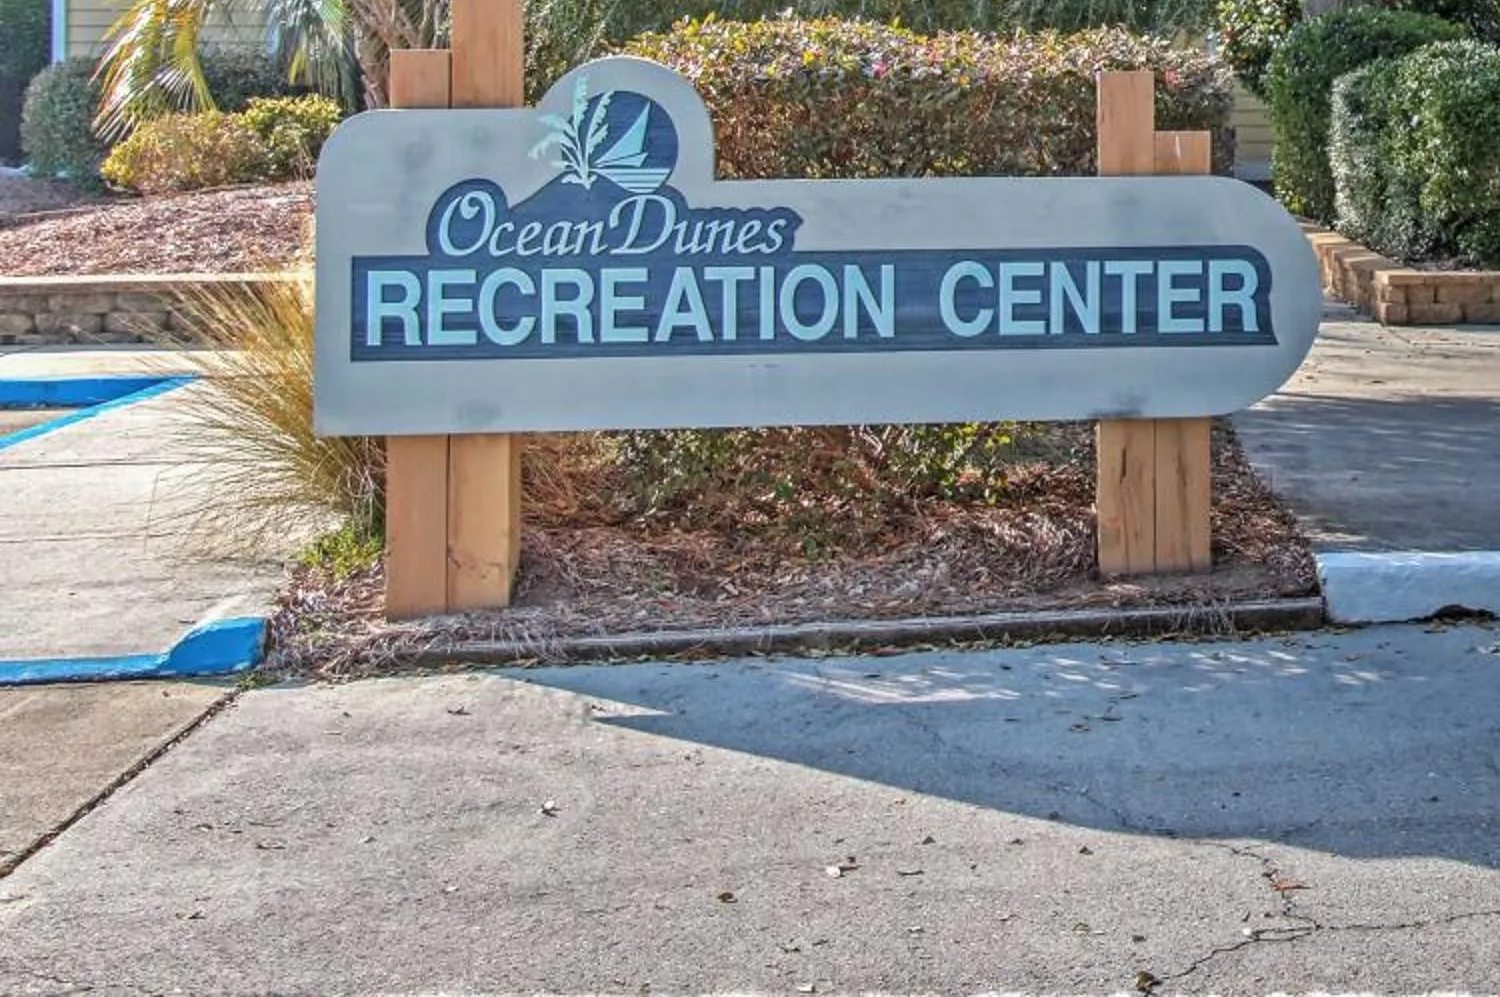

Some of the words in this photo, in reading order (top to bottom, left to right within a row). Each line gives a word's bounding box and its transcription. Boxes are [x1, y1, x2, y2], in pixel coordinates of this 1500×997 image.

[437, 189, 609, 257] Ocean
[609, 193, 787, 255] Dunes
[365, 263, 895, 346] RECREATION
[939, 260, 1259, 338] CENTER
